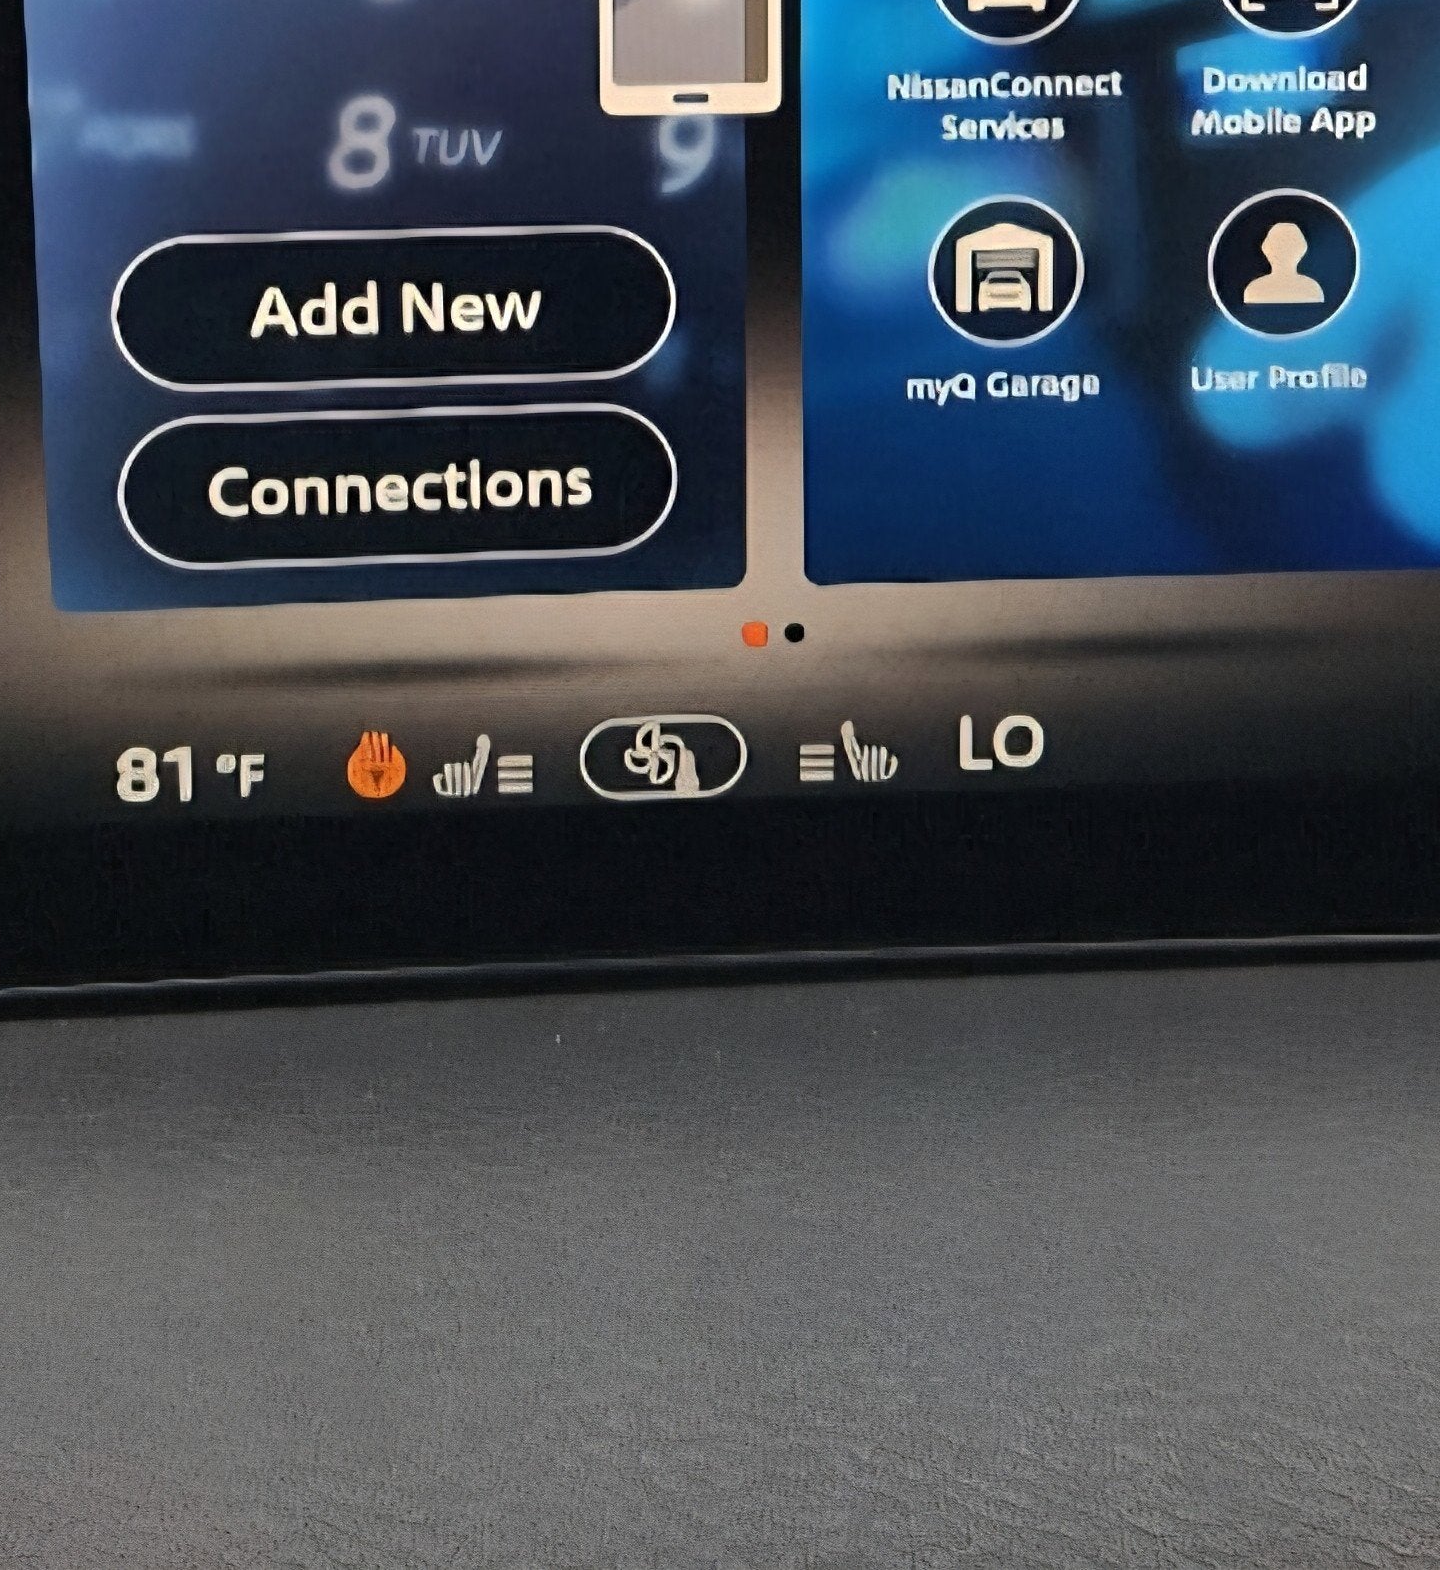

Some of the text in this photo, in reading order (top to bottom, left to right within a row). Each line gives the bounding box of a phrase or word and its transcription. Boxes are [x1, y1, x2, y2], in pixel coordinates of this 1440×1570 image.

[886, 71, 1123, 101] NissanConnect
[1202, 63, 1368, 94] Download
[941, 110, 1066, 142] Services
[1191, 107, 1376, 138] Mobile App
[328, 95, 503, 191] 8 TUV
[250, 281, 542, 340] Add New
[987, 371, 1100, 400] Garage
[1191, 363, 1368, 391] User Profile
[208, 459, 592, 518] Connections
[959, 714, 1044, 771] LO
[115, 746, 193, 802] 81
